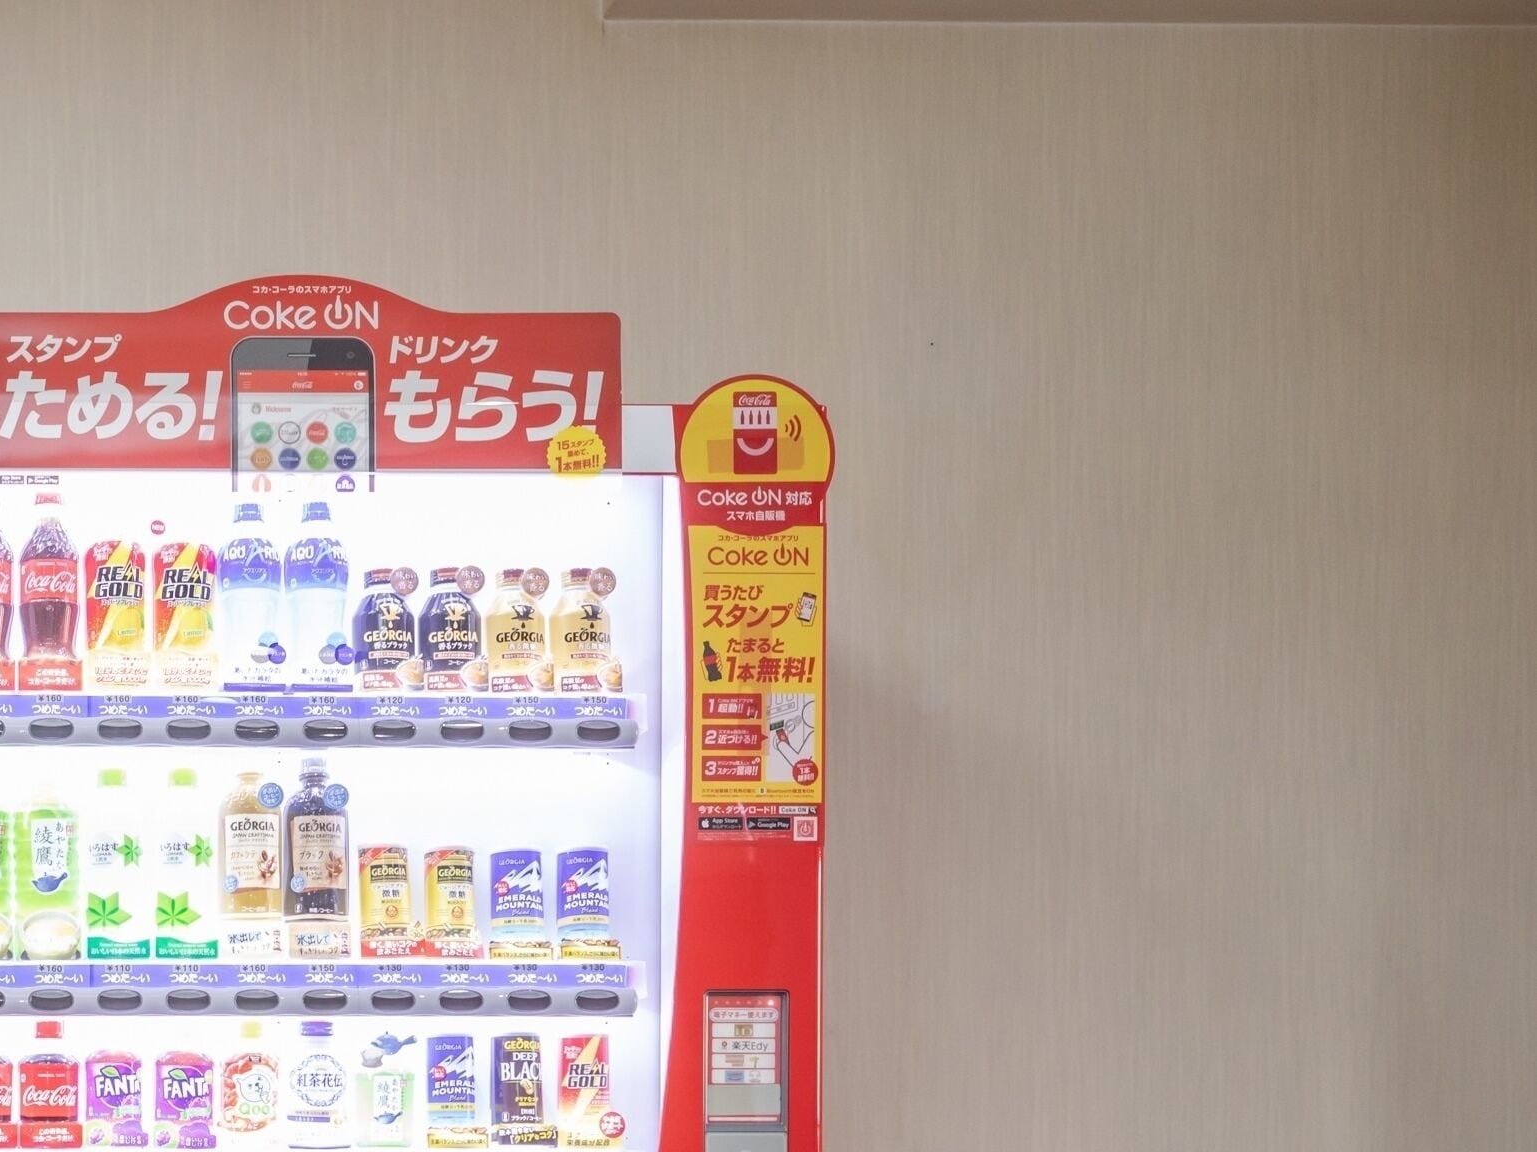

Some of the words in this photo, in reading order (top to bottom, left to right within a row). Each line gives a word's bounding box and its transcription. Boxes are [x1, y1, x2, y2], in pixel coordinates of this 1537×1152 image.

[252, 284, 352, 295] コカ・コーラのスマホアプリ
[223, 301, 316, 330] Coke
[324, 295, 379, 330] ON
[7, 335, 122, 363] スタンプ
[390, 335, 498, 363] ドリンク
[384, 371, 605, 442] もらう!
[698, 489, 747, 505] Coke
[752, 486, 782, 505] ON
[786, 492, 812, 506] 対応
[727, 511, 786, 521] スマホ自販機
[708, 547, 768, 566] Coke
[773, 543, 809, 566] ON
[97, 560, 143, 581] REAL
[163, 564, 211, 584] REAL
[95, 582, 143, 599] GOLD
[161, 584, 210, 600] GOLD
[704, 585, 763, 601] 買うたび
[703, 603, 793, 628] スタンプ
[727, 638, 784, 653] たまると
[727, 657, 815, 682] 1本無料!
[516, 696, 538, 704] ¥150
[705, 730, 716, 744] 2
[718, 735, 757, 744] 近づける!!
[705, 761, 716, 775] 3
[231, 818, 275, 831] GEORGIA
[89, 842, 118, 852] いろはす
[372, 866, 406, 876] GEORGIA
[499, 895, 542, 903] EMERALD
[732, 1041, 768, 1051] 楽天Edy
[569, 1058, 607, 1075] REAL
[297, 1073, 343, 1087] 紅茶花伝
[568, 1076, 607, 1088] GOLD
[239, 1103, 270, 1115] Qoo
